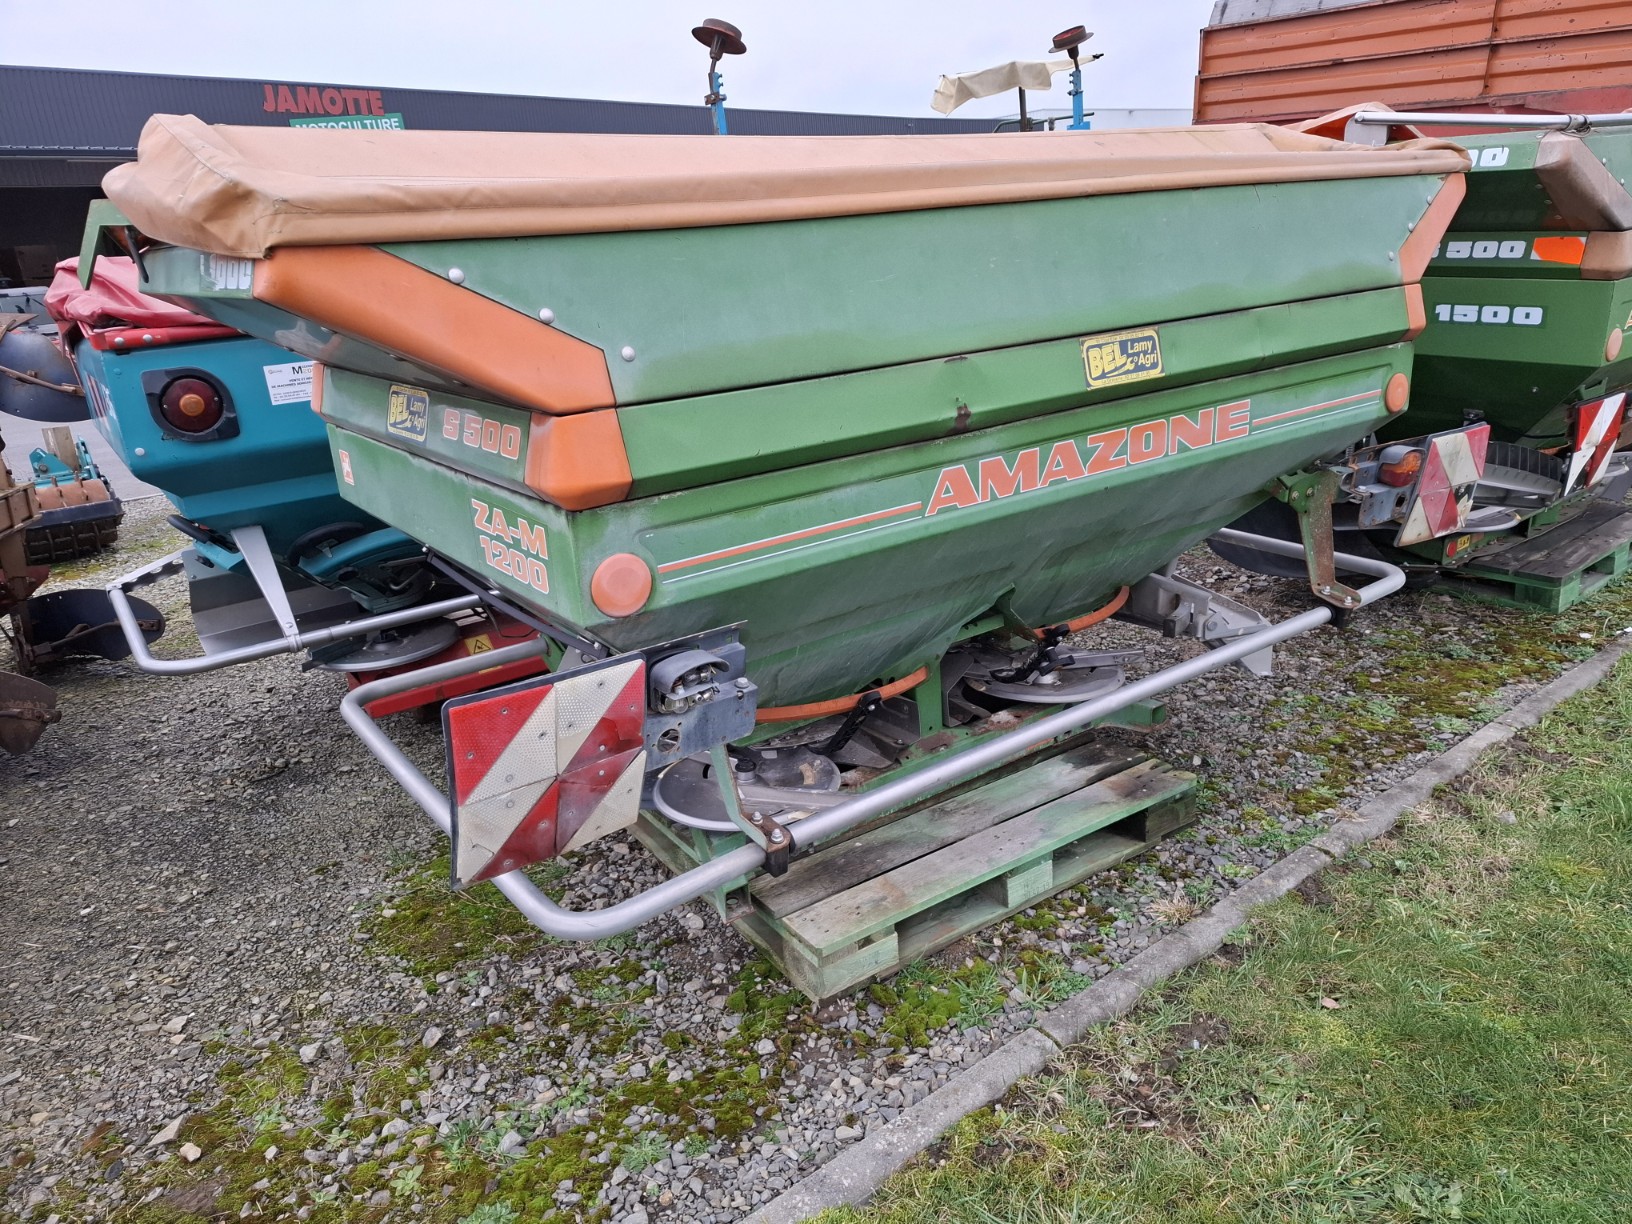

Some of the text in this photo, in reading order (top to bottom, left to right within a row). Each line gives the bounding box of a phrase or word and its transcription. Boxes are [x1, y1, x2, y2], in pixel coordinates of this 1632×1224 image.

[263, 84, 384, 116] JAMOTTE
[1435, 304, 1543, 325] 1500
[1088, 342, 1127, 378] BEL
[1128, 340, 1153, 353] Lamy
[1138, 351, 1157, 367] Agri
[463, 415, 521, 460] 500
[925, 399, 1250, 516] AMAZONE
[471, 498, 549, 560] ZA-M
[480, 536, 549, 594] 1200
